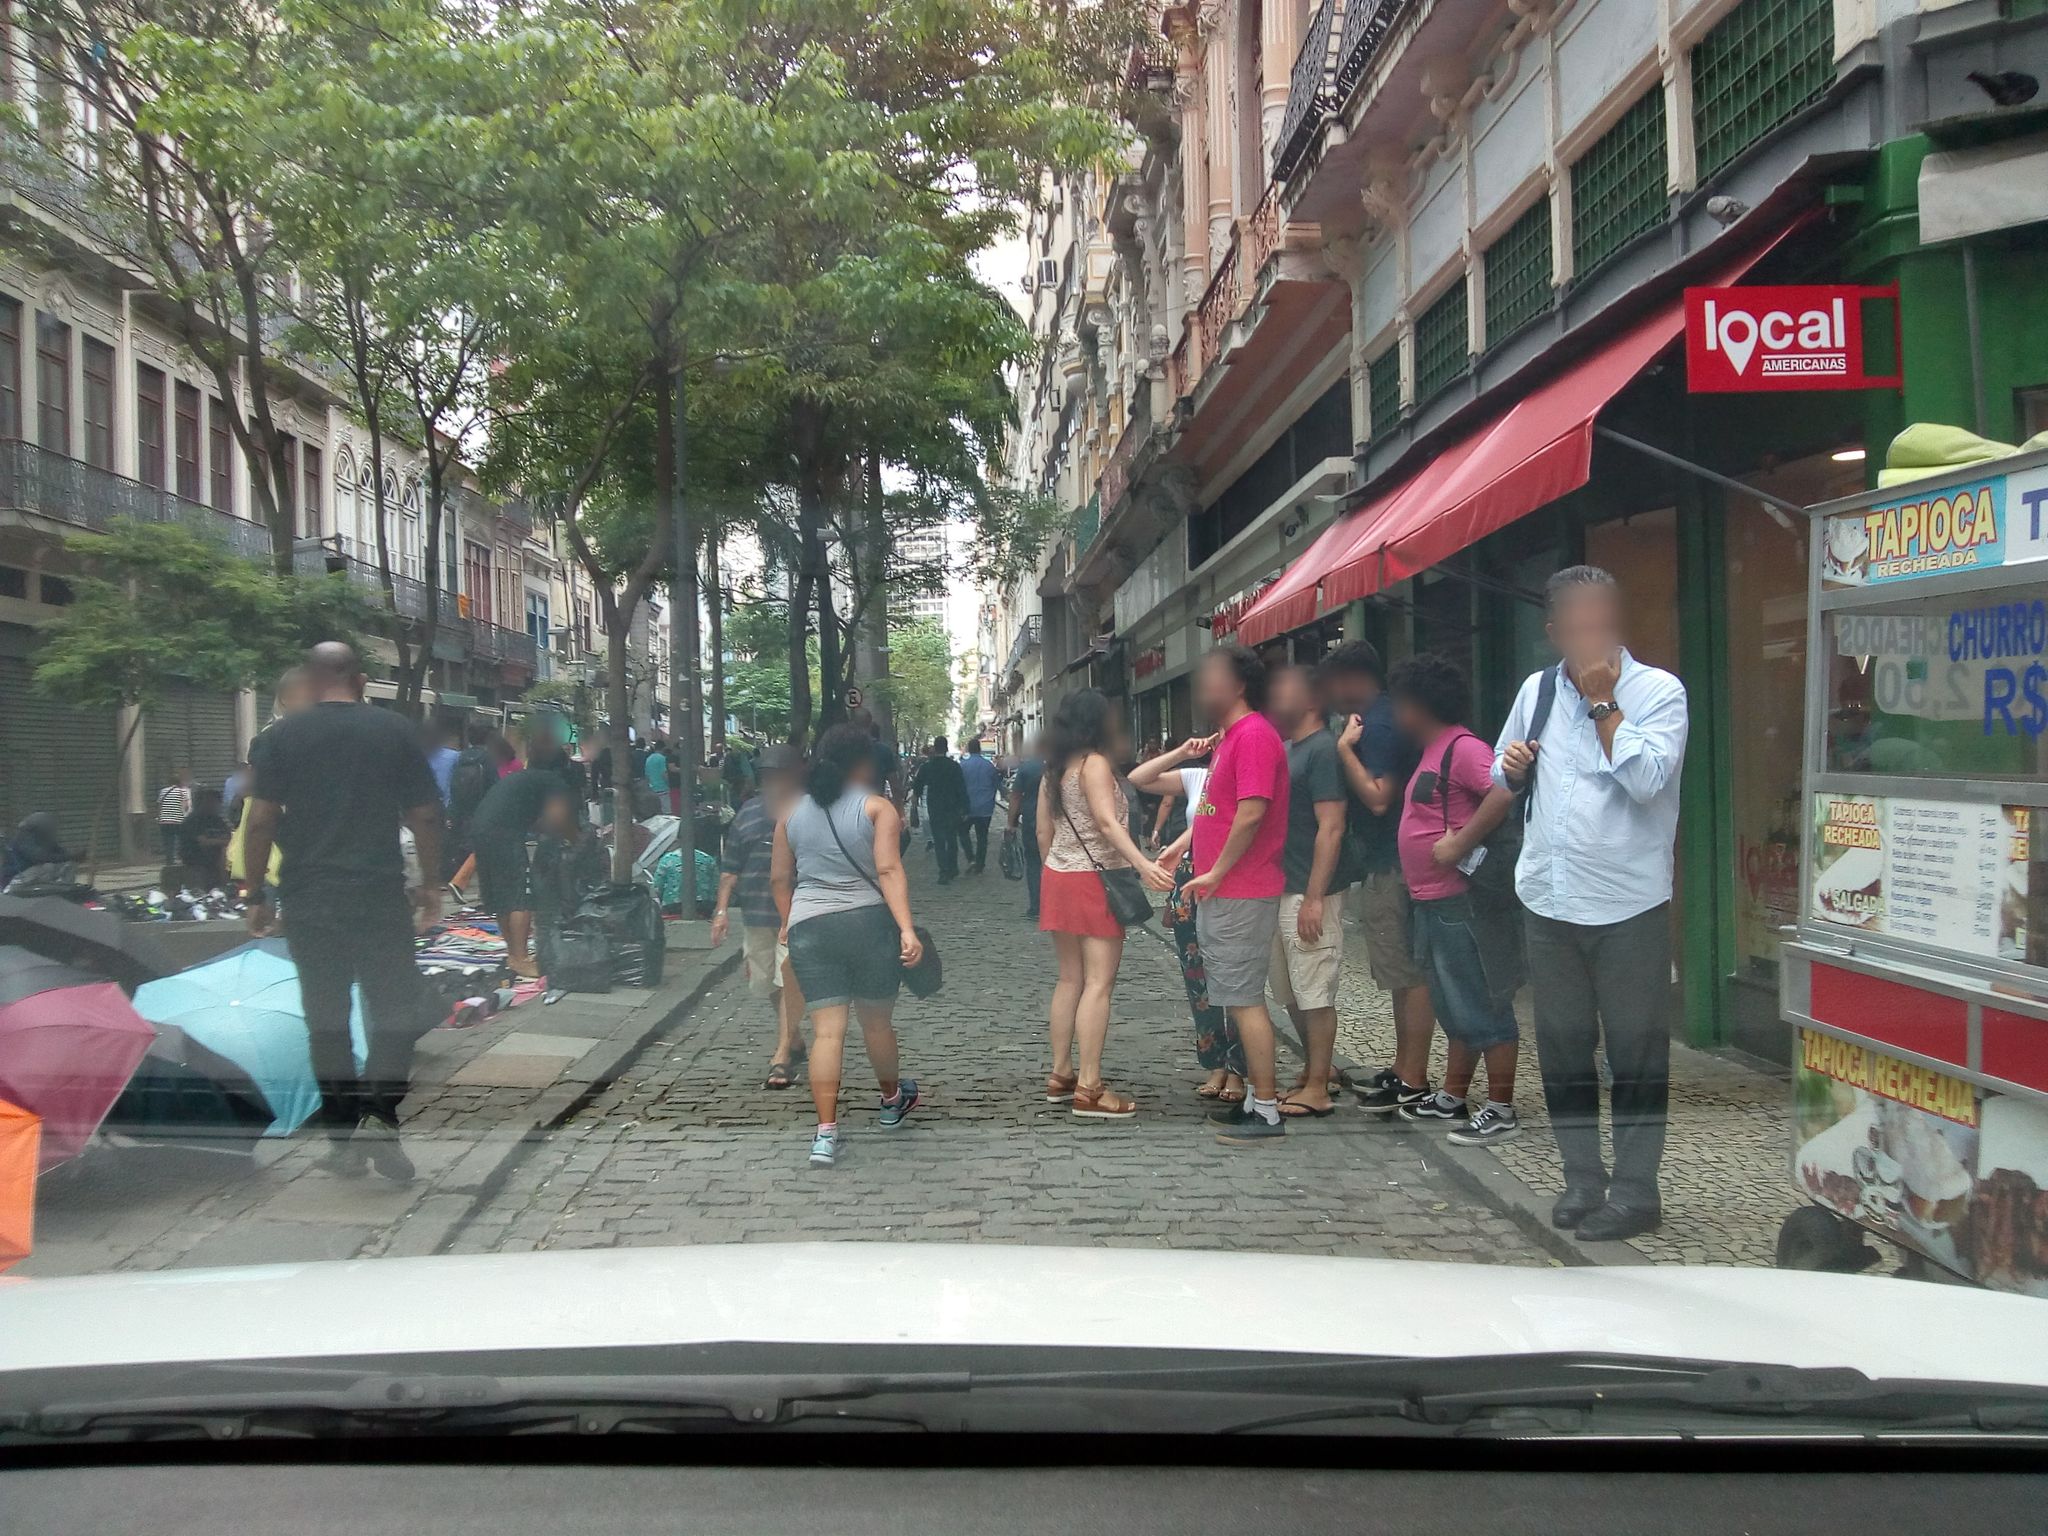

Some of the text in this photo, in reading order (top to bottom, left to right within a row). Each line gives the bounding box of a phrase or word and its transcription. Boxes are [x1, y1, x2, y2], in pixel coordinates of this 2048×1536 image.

[1704, 298, 1846, 376] local
[1762, 358, 1847, 371] AMERICANAS
[1866, 487, 1997, 561] TAPIOCA
[1877, 548, 1979, 578] RECHEADA
[1829, 801, 1876, 825] TAPIOCA
[1824, 824, 1881, 850] RECHEADA
[1802, 1028, 1977, 1129] TAPIOCA RECHEADA
